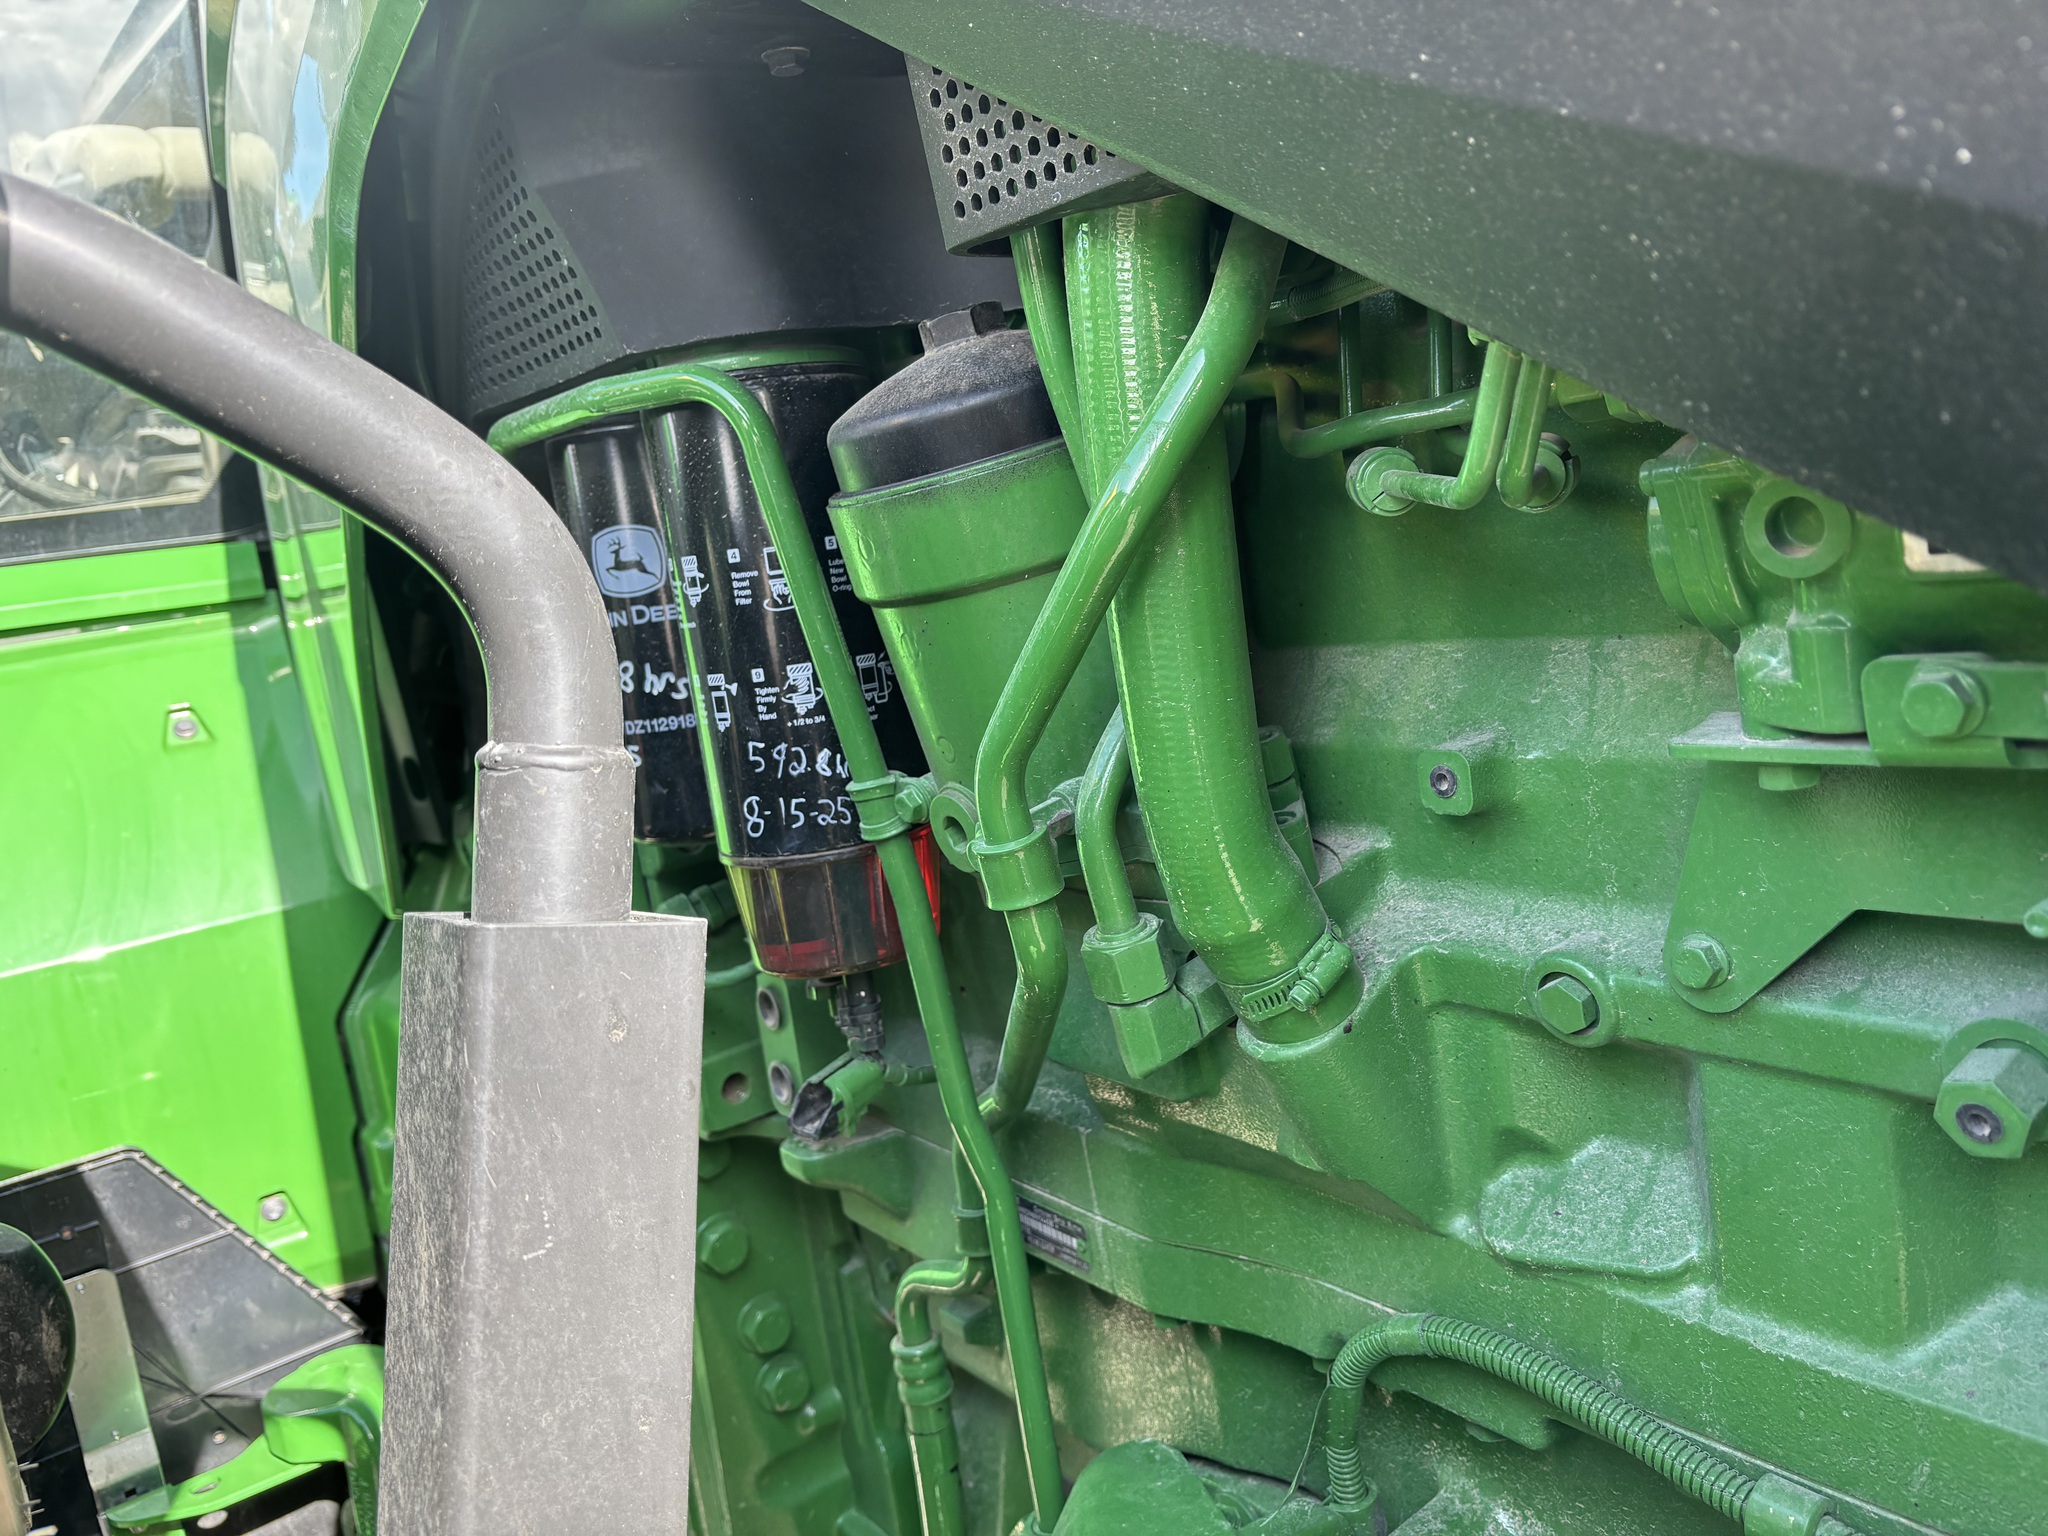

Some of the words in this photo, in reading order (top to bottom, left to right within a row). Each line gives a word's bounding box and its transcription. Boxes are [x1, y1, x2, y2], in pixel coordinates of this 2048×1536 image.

[730, 570, 759, 580] Remove
[829, 567, 845, 575] New
[732, 579, 750, 589] Bowl
[831, 574, 848, 584] Bowl
[733, 588, 752, 598] From
[832, 584, 852, 593] O-ring
[735, 597, 753, 606] Filter
[630, 603, 679, 625] DEE
[643, 661, 690, 700] hrs
[754, 686, 780, 697] Tighten
[756, 695, 777, 705] Firmly
[757, 705, 767, 713] By
[759, 712, 778, 721] Hand
[792, 718, 805, 727] 1/2
[805, 717, 814, 725] to
[814, 715, 826, 723] 3/4
[624, 713, 697, 736] DZ112918
[743, 795, 852, 838] 8-15-25
